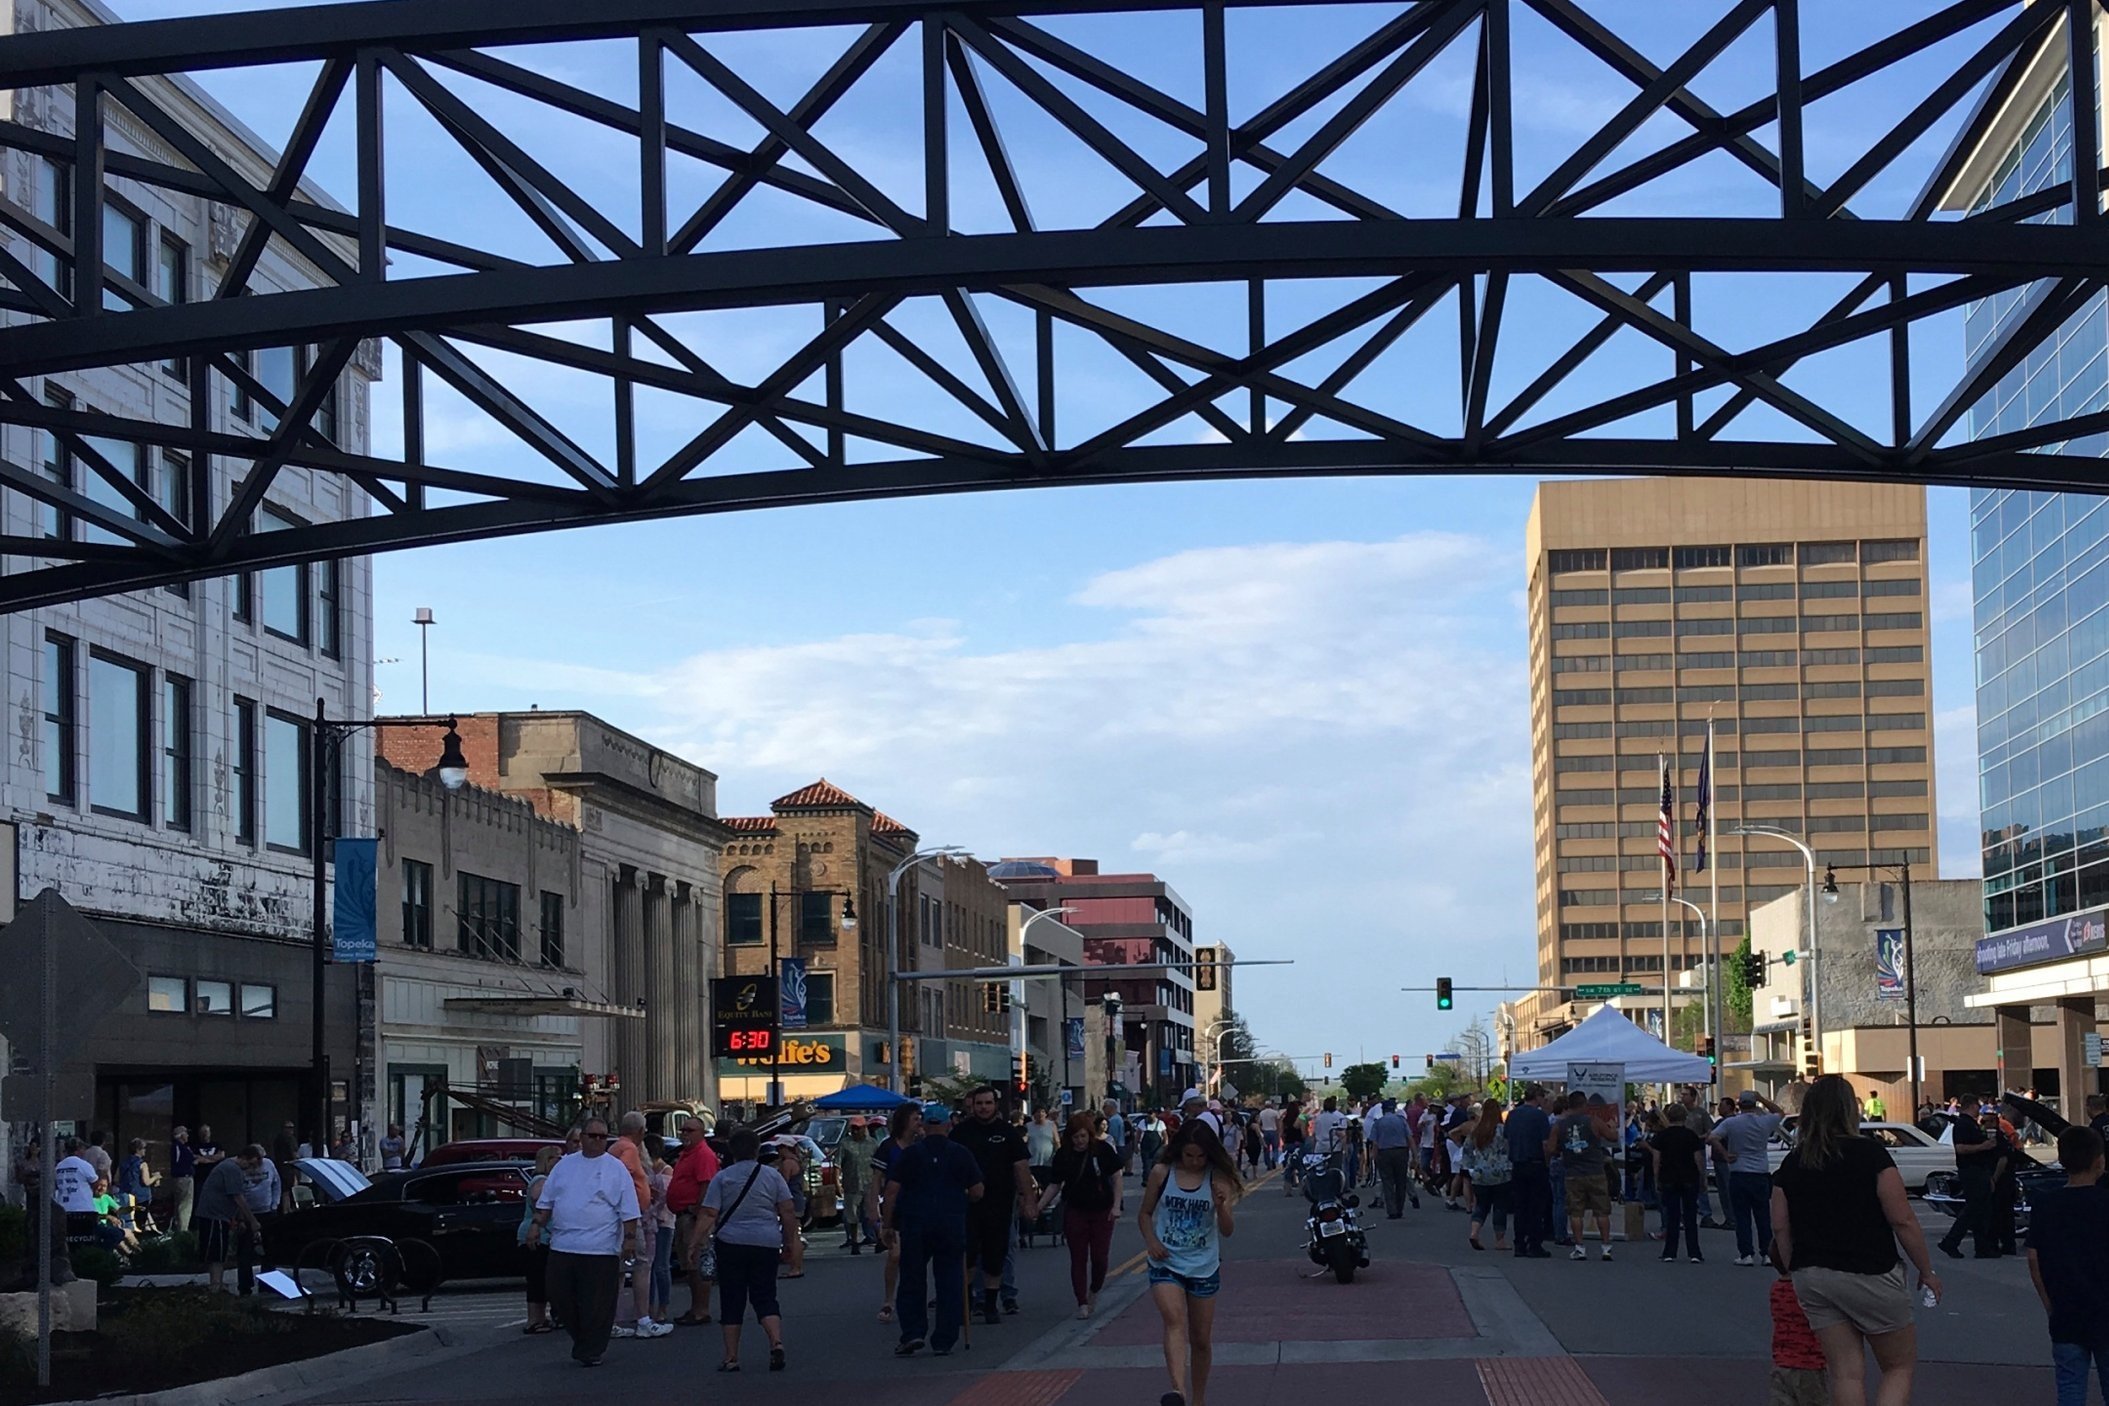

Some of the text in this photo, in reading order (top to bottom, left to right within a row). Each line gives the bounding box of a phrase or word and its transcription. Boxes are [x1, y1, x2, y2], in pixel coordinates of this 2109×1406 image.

[335, 938, 376, 950] Topeka
[1977, 944, 1997, 965] shooting
[1997, 942, 2006, 959] late
[2006, 939, 2022, 961] Friday
[730, 1031, 769, 1049] 6:30
[737, 1040, 831, 1066] lfe's
